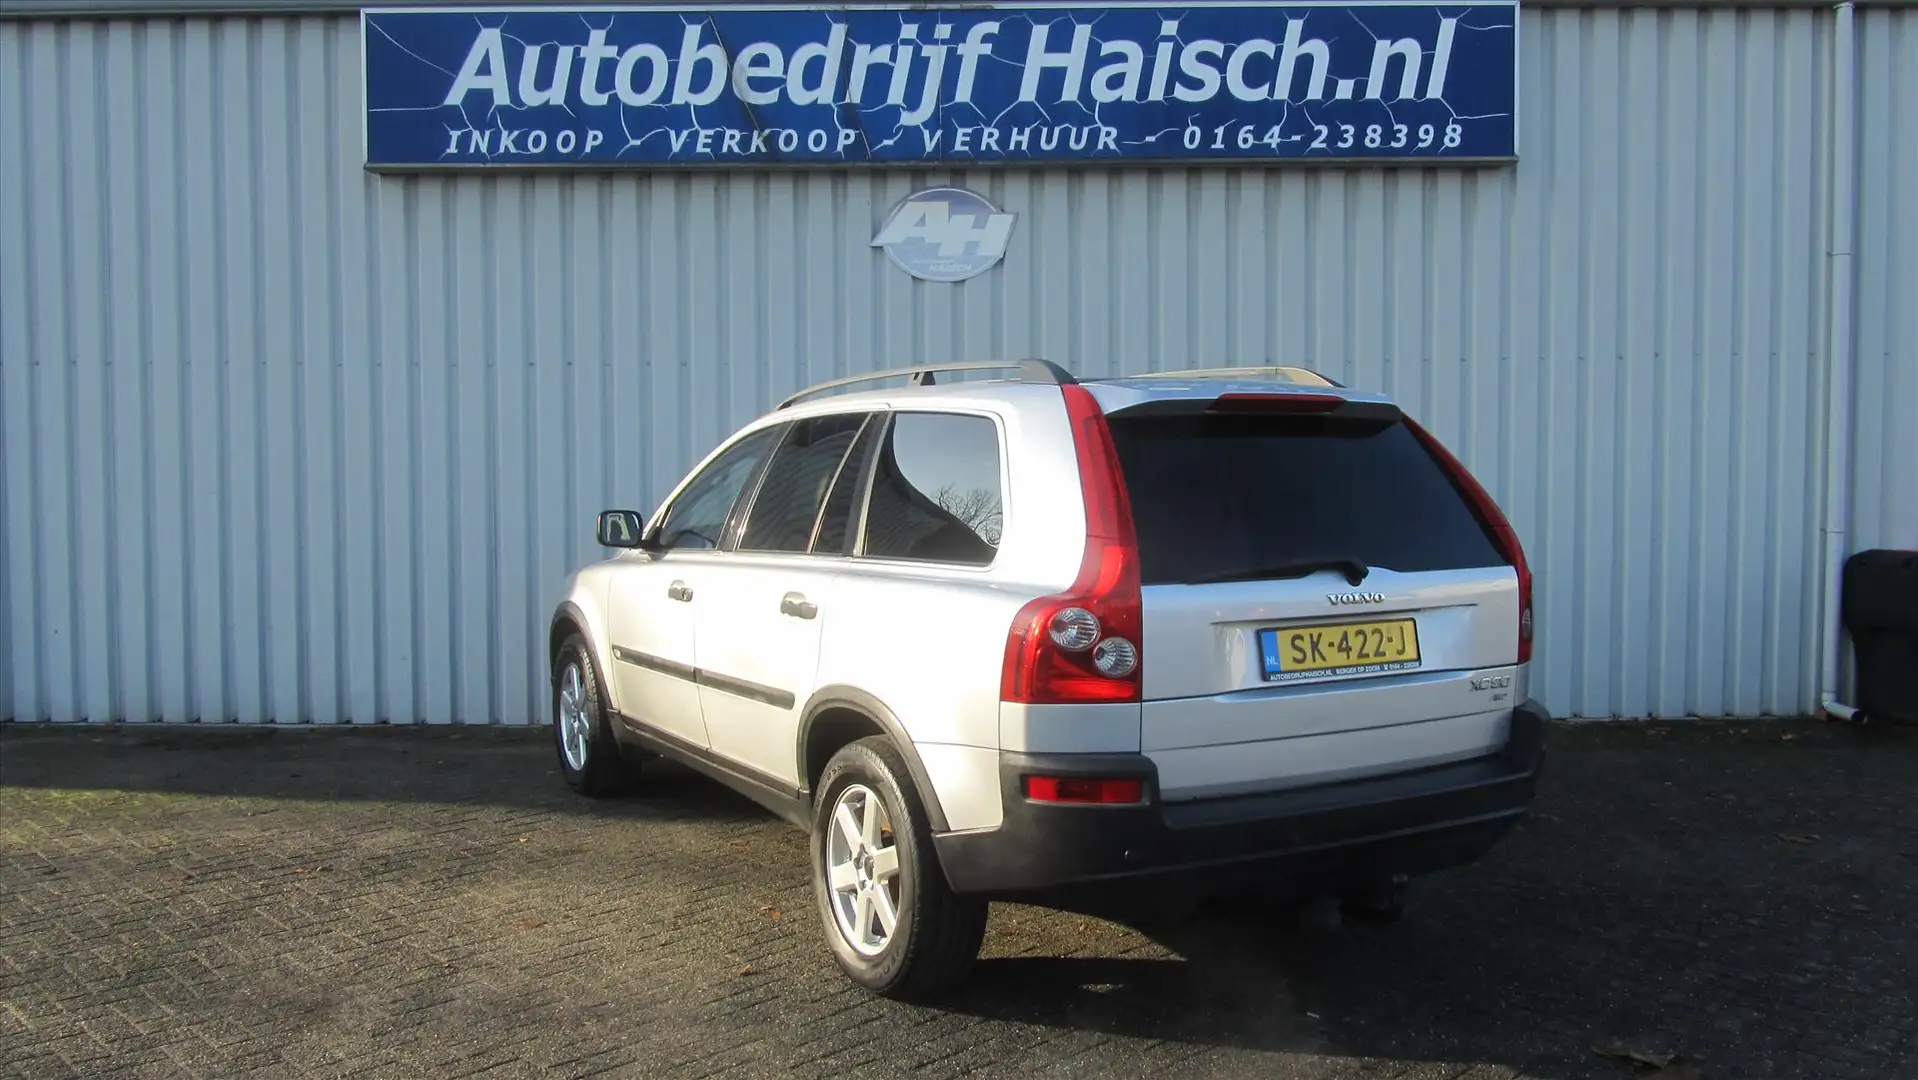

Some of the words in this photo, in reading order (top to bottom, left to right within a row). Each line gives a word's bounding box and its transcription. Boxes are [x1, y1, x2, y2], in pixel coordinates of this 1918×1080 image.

[443, 21, 999, 126] Autobedrijf
[1018, 18, 1456, 101] Haisch.nl
[446, 130, 603, 154] INKOOP
[669, 129, 856, 153] VERKOOP
[923, 126, 1118, 151] VERHUUR
[1184, 124, 1463, 149] 0164-238398
[870, 202, 1014, 257] AH
[1327, 592, 1385, 606] VOLVO
[1265, 656, 1279, 666] NL
[1290, 625, 1406, 664] SK-422-J
